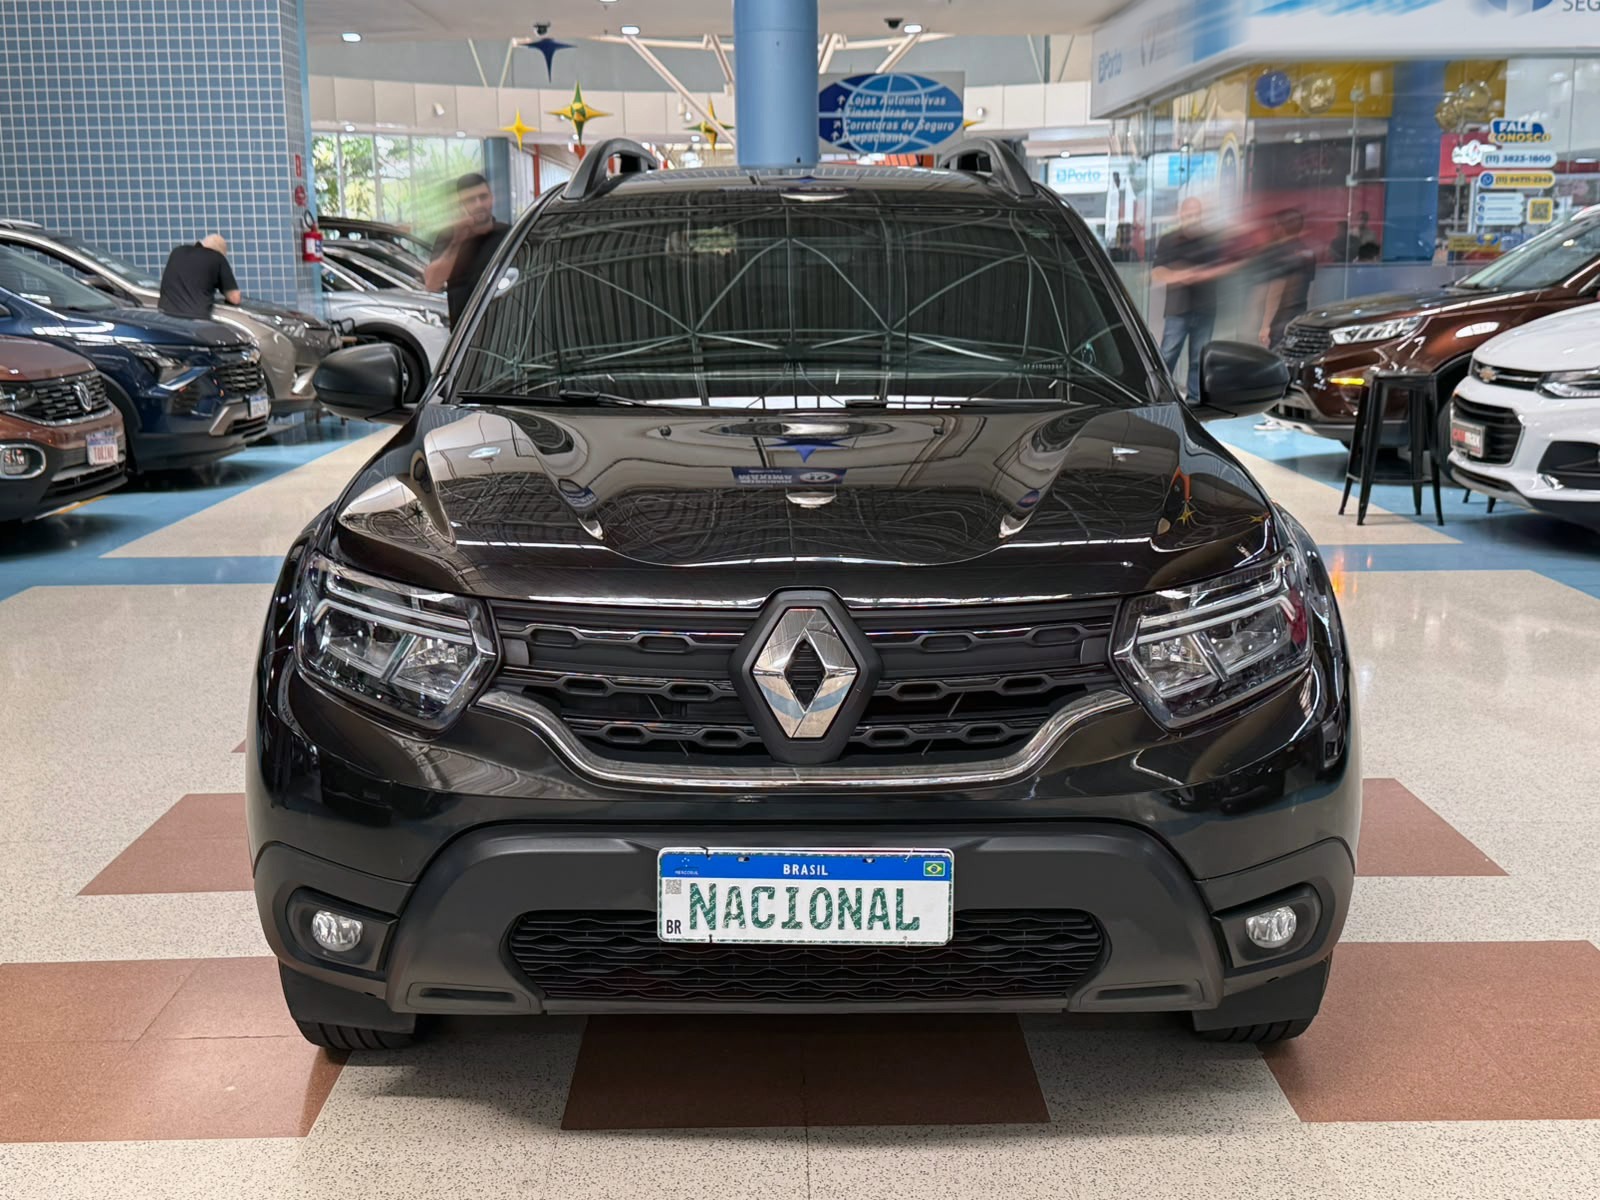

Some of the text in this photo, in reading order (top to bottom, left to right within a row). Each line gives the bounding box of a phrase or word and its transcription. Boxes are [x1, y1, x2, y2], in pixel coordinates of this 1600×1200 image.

[849, 94, 946, 107] Lojas Automotivas
[845, 120, 955, 133] Corretoras de Seguro
[1499, 121, 1529, 133] FALE
[1488, 133, 1552, 143] CONOSCO
[1485, 155, 1500, 164] (11)
[1067, 170, 1100, 183] Porto
[783, 863, 829, 876] BRASIL
[689, 882, 921, 931] NACIONAL
[666, 919, 682, 935] BR
